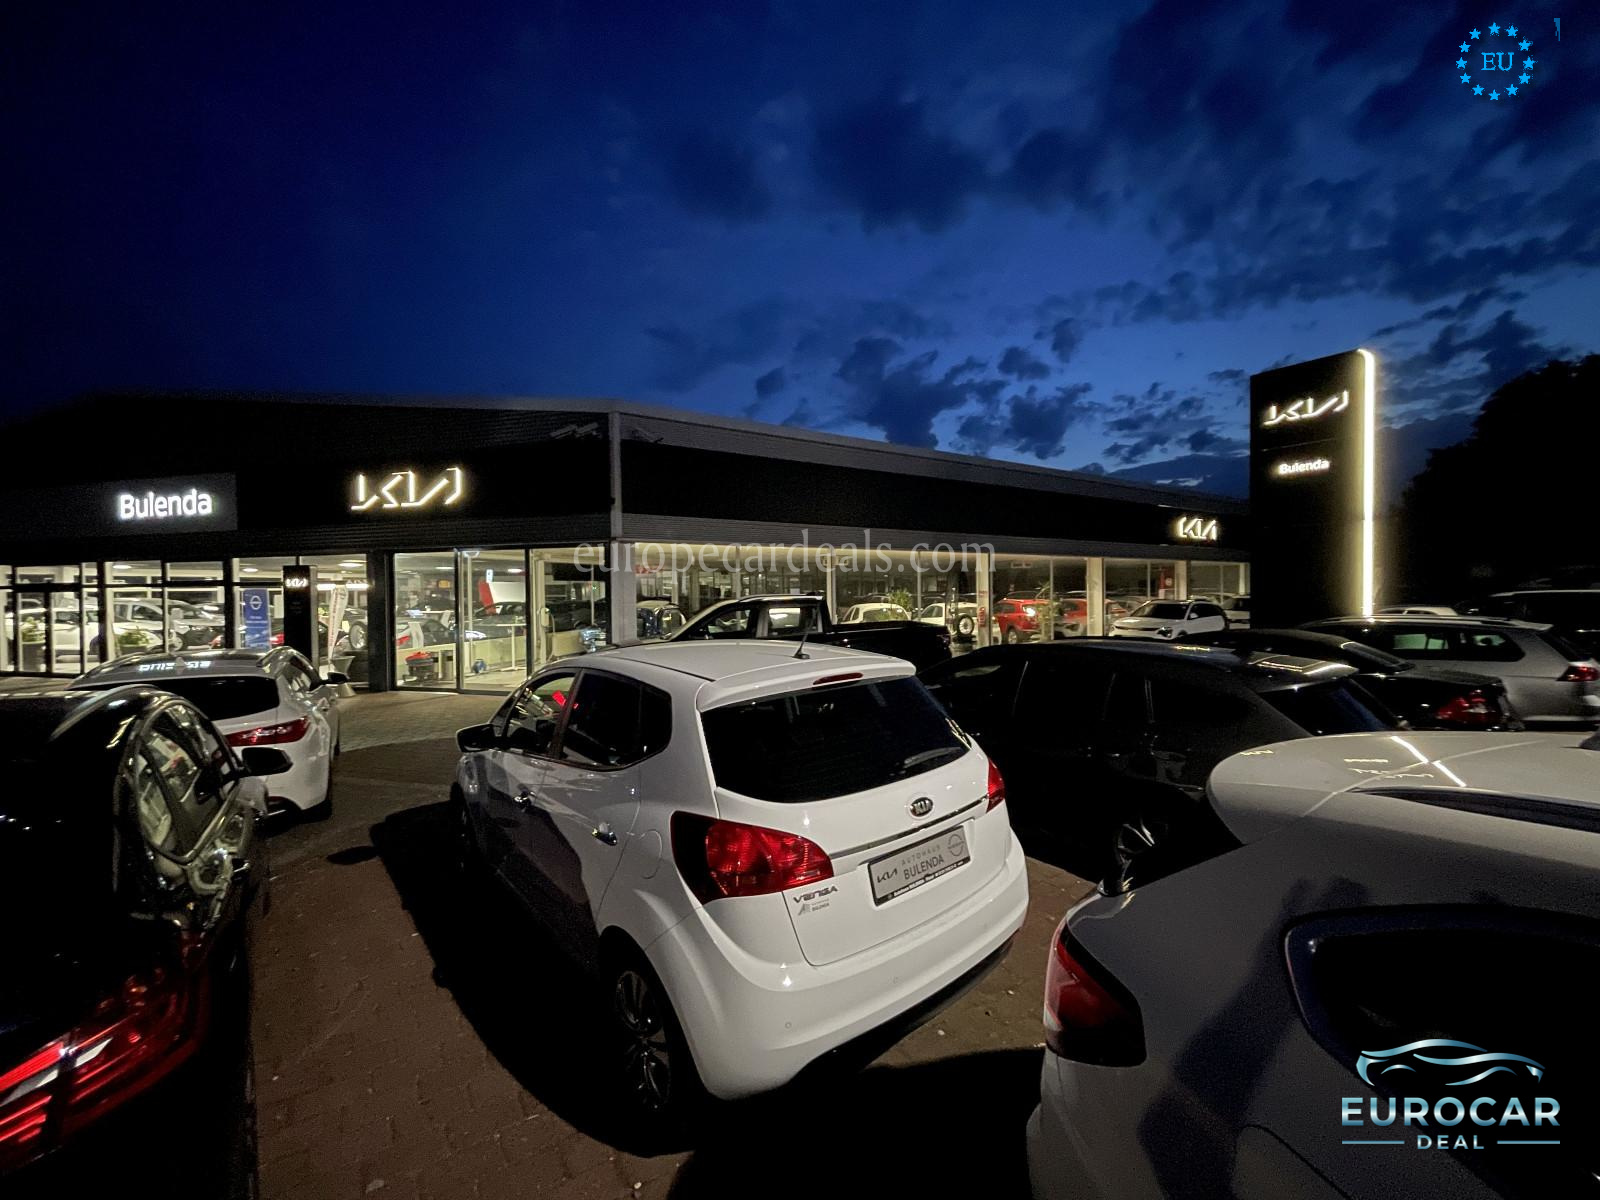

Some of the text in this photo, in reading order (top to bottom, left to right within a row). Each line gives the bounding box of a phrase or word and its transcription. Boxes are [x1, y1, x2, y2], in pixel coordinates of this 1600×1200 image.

[1277, 458, 1331, 475] Bulenda
[351, 467, 464, 511] KIA
[118, 488, 213, 520] Bulenda
[1175, 516, 1218, 541] KIA
[912, 799, 931, 815] KIA
[903, 855, 945, 880] BULENDA
